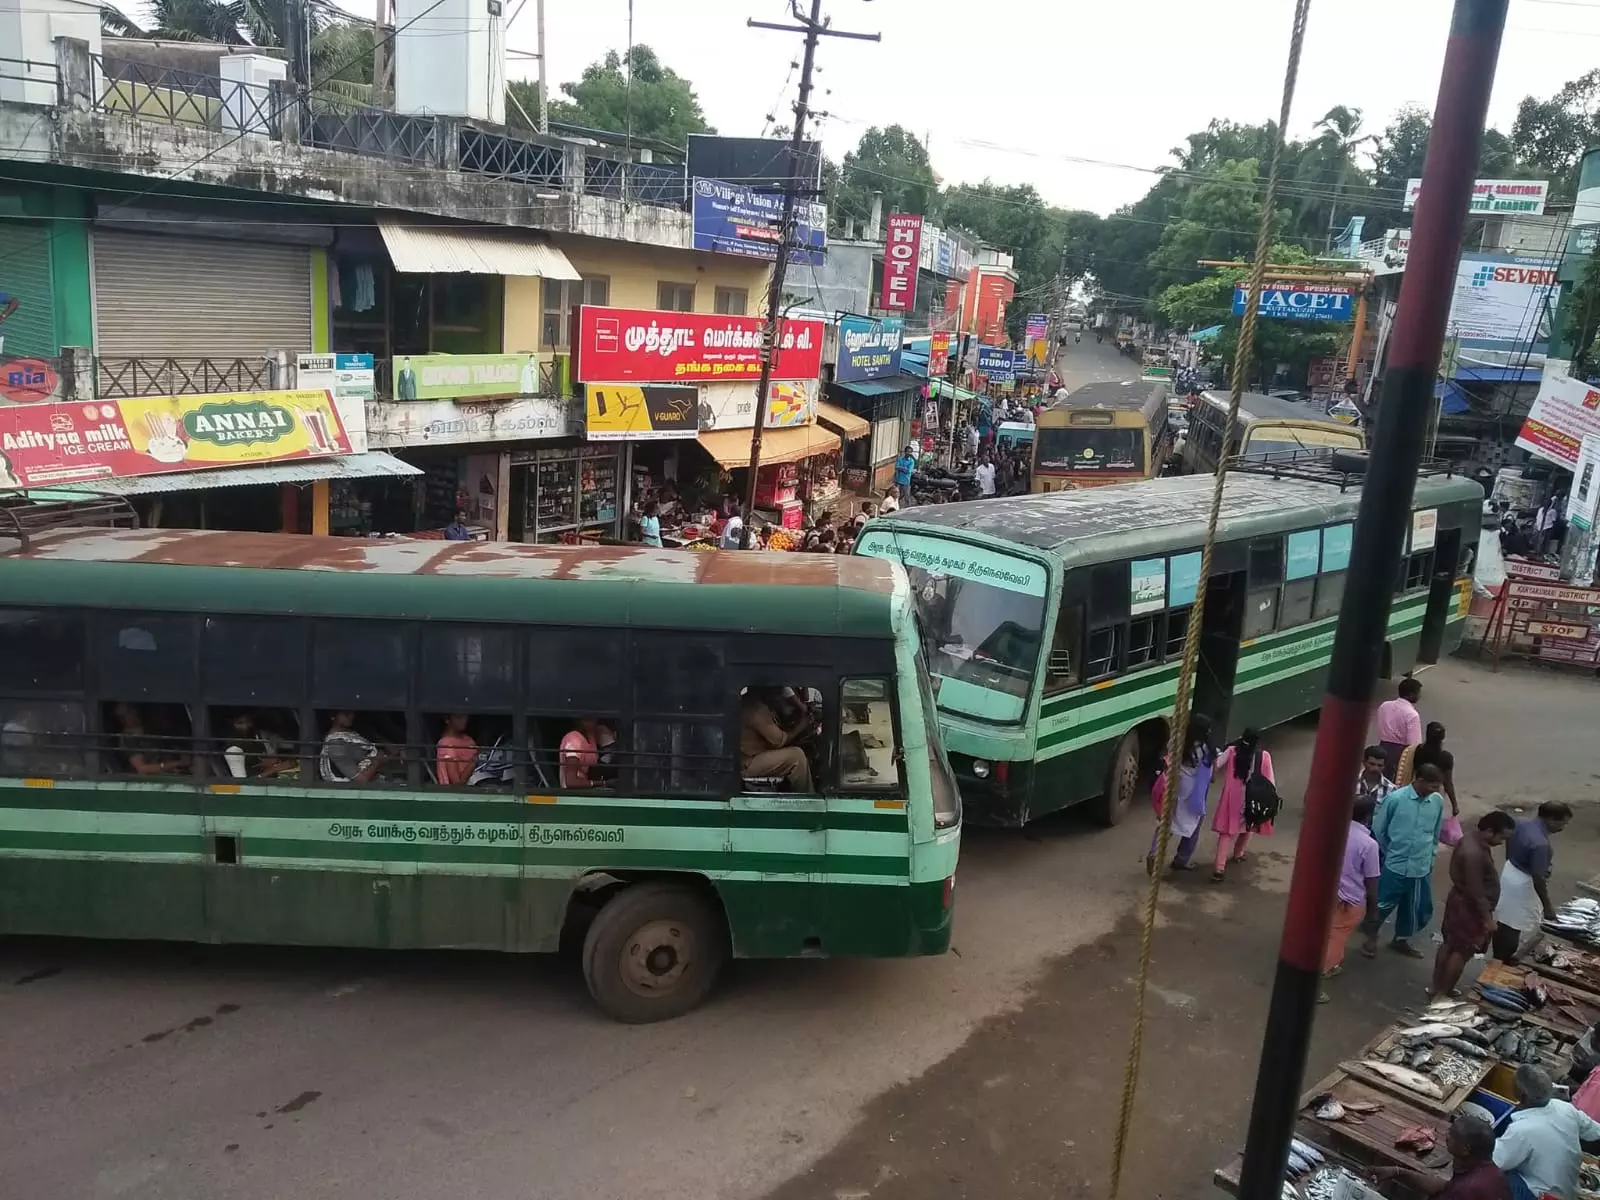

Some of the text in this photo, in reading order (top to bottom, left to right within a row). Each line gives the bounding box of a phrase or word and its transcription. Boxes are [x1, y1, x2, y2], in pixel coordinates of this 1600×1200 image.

[1496, 185, 1542, 196] SOLUTIONS
[746, 192, 772, 208] Vision
[1494, 201, 1539, 211] ACADEMY
[890, 219, 920, 228] SANTHI
[889, 228, 914, 306] HOTEL
[1238, 290, 1350, 310] MACET
[625, 319, 695, 357] முத்தூட்
[674, 360, 763, 376] தங்க நகை கட
[852, 354, 891, 368] HOTEL SANTHI
[980, 357, 1011, 369] STUDIO
[8, 365, 46, 387] Ria
[195, 410, 288, 433] ANNAI
[654, 412, 681, 422] V-GUARD
[3, 423, 128, 451] Adityaa milk
[216, 428, 275, 441] BAKERY
[64, 440, 132, 456] ICE CREAM
[967, 561, 1031, 587] திருநெல்வேலி
[1511, 564, 1543, 576] DISTRICT
[1559, 590, 1590, 600] DISTRICT
[1541, 625, 1575, 636] STOP
[328, 822, 363, 838] அரசு
[367, 822, 475, 844] போக்குவரத்துக்
[528, 823, 625, 844] திருநெல்வேலி
